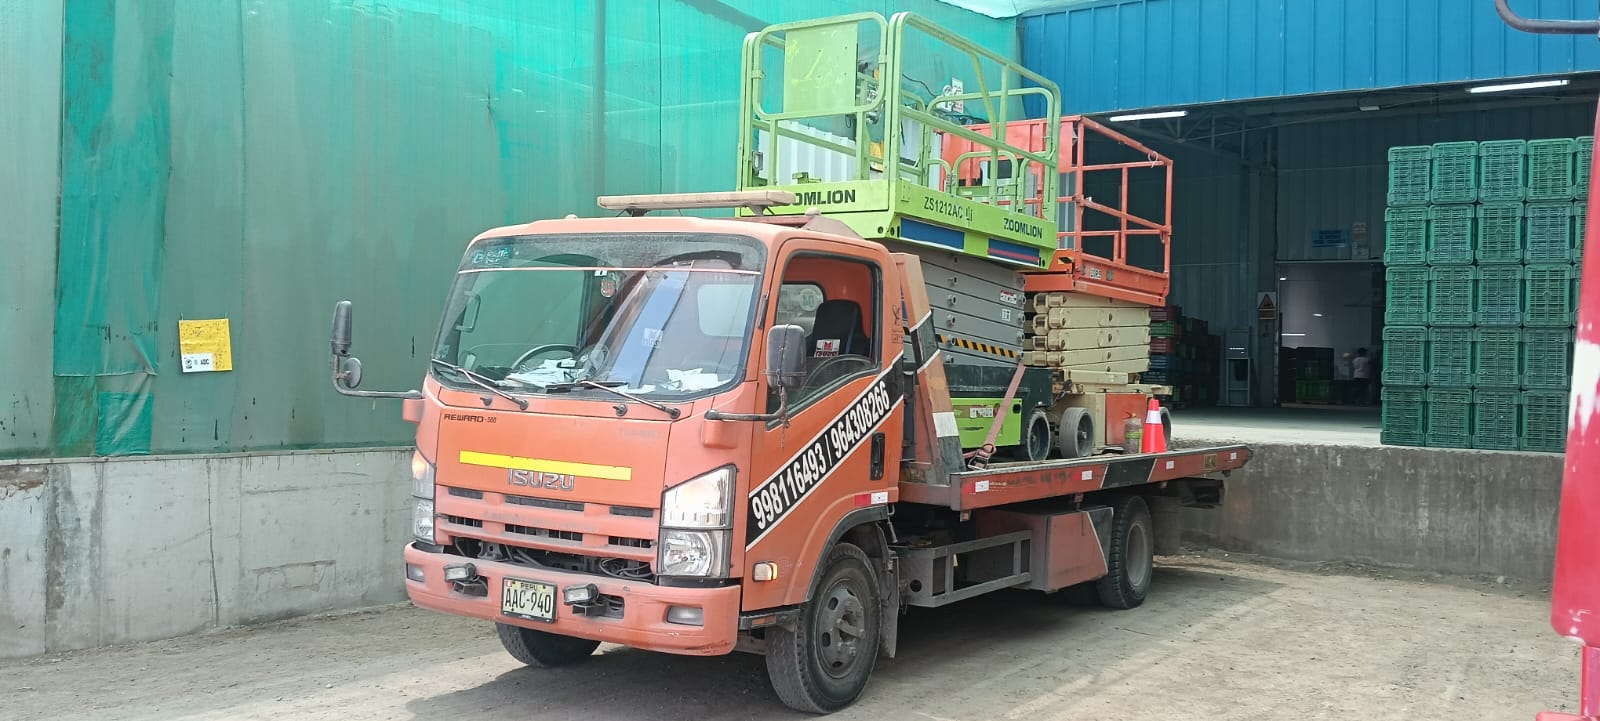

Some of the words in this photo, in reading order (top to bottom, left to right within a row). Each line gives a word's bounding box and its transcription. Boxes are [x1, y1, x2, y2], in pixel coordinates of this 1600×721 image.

[792, 189, 856, 206] OMLION
[1003, 217, 1043, 239] ZOOMLION
[752, 442, 827, 529] 998116493
[824, 433, 833, 467] /
[830, 380, 890, 459] 964308266
[508, 468, 575, 491] ISUZU
[520, 582, 537, 592] PERU
[505, 588, 552, 614] AAC-940
